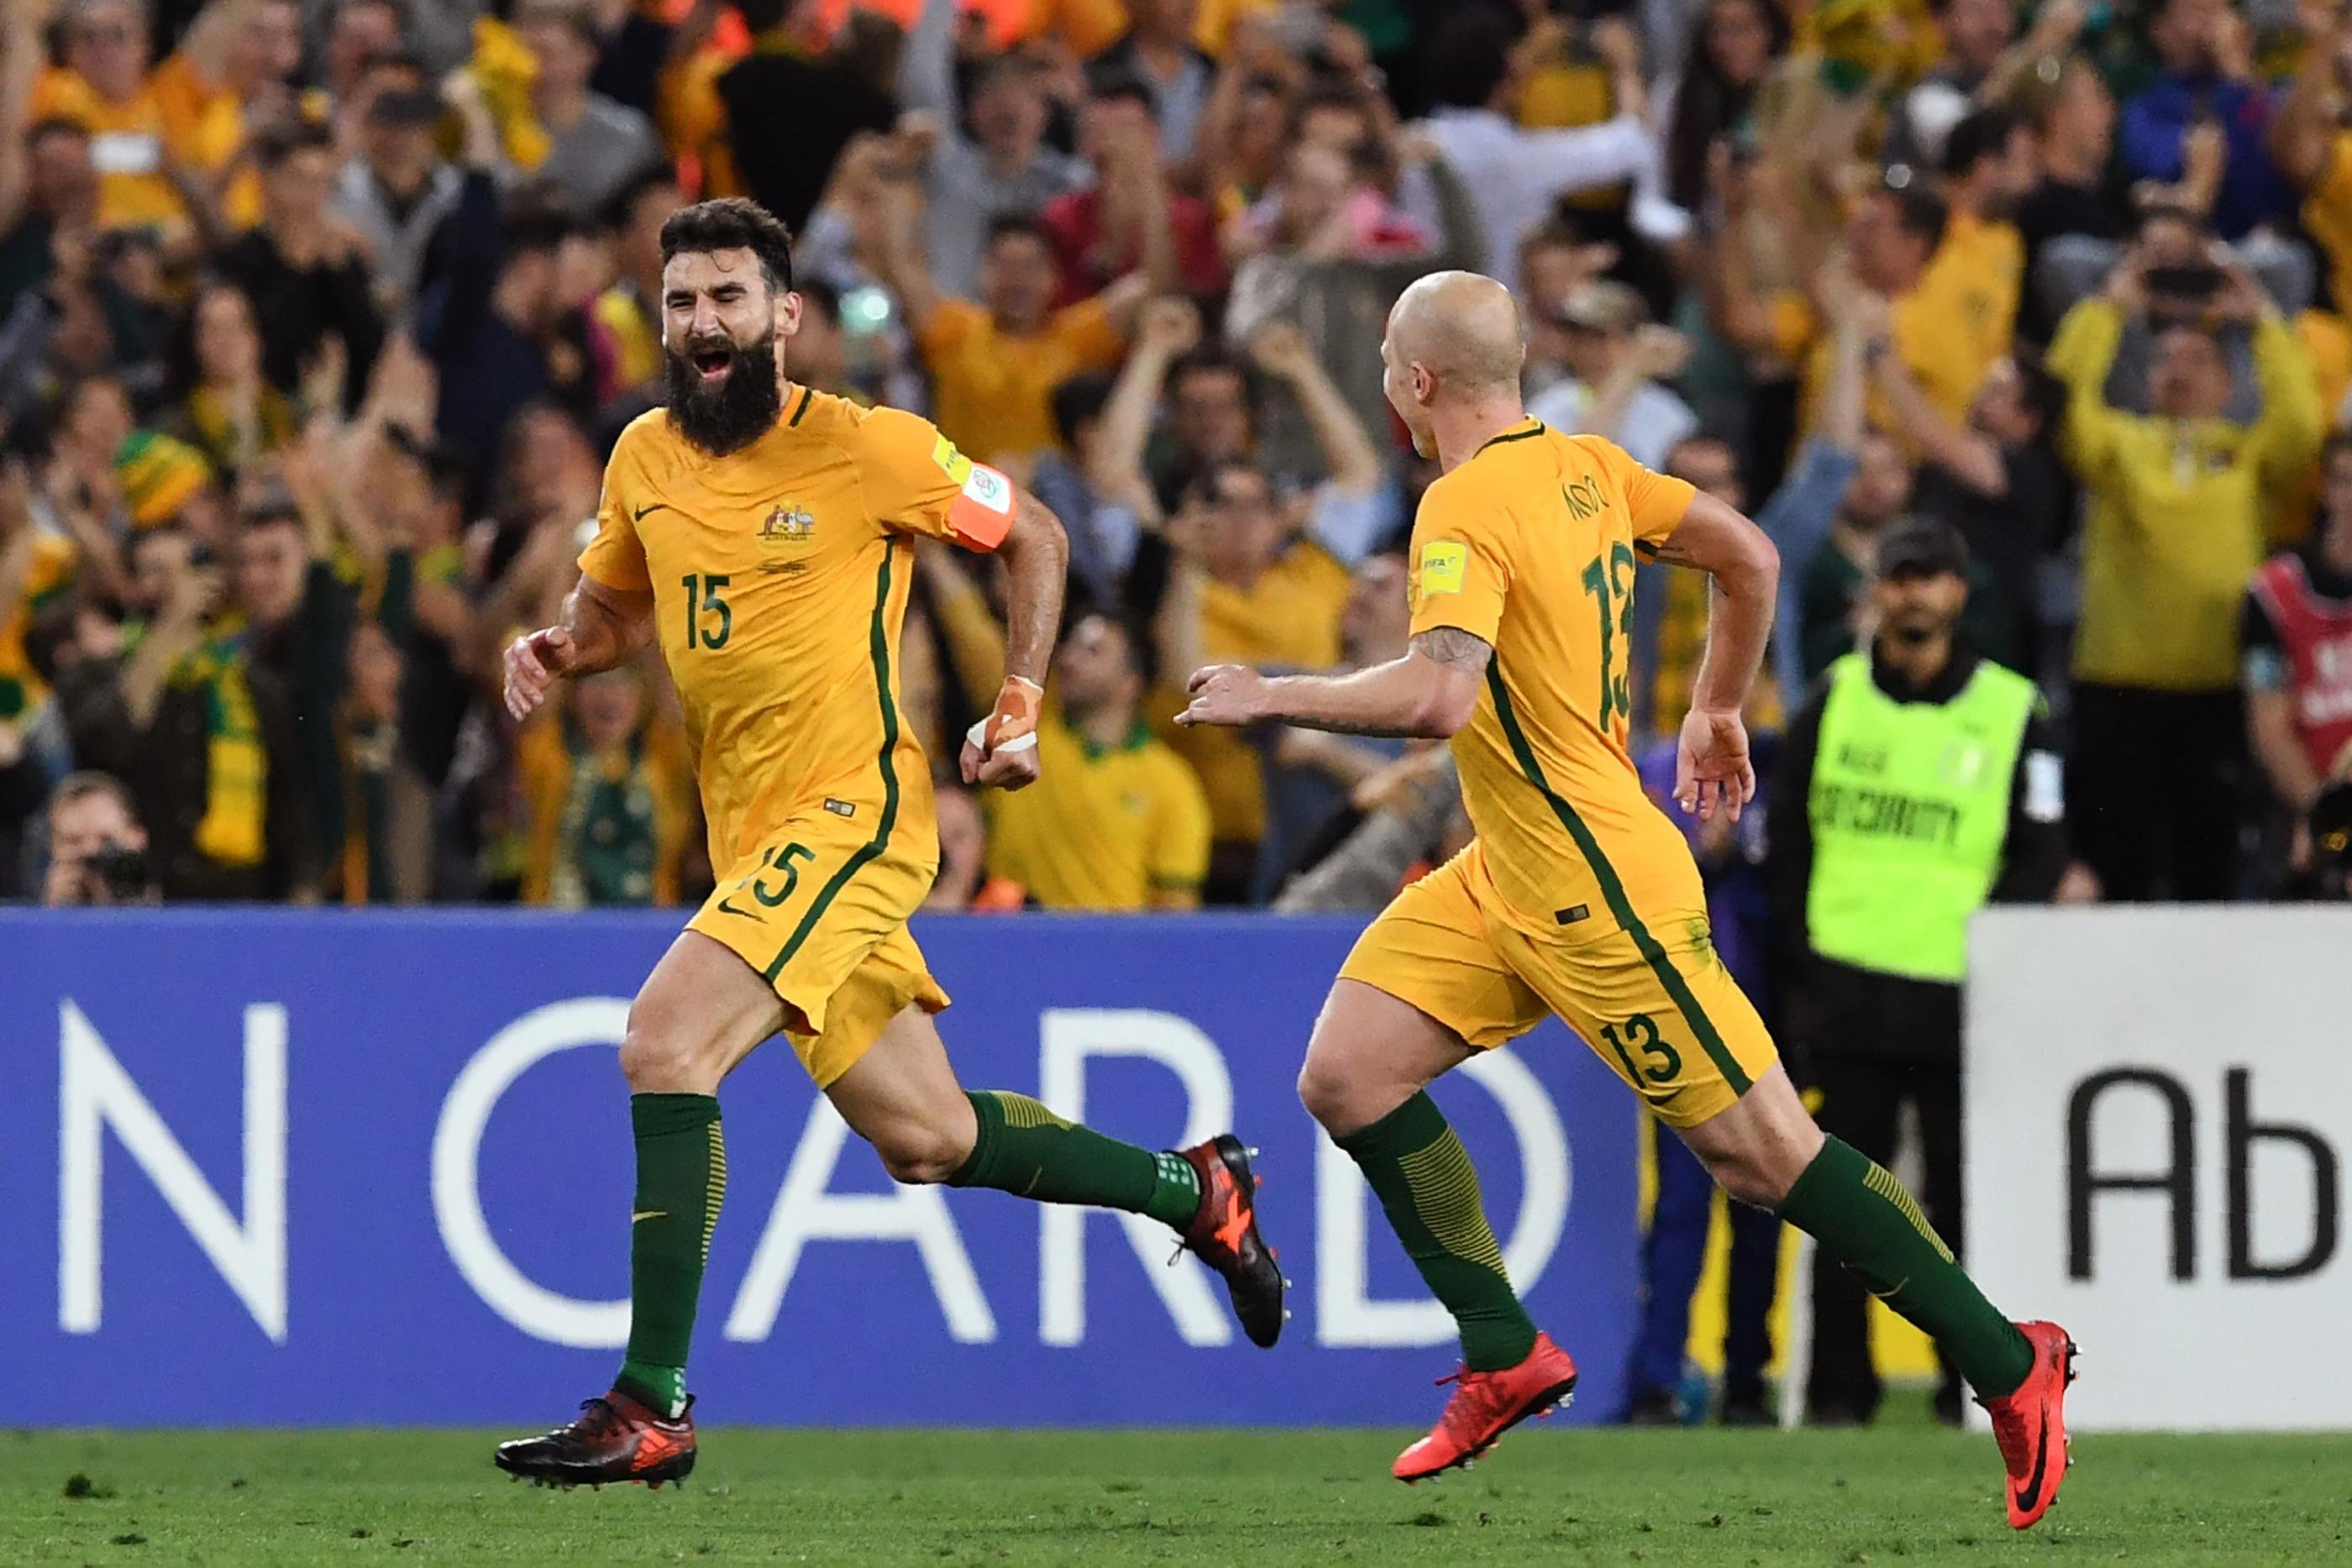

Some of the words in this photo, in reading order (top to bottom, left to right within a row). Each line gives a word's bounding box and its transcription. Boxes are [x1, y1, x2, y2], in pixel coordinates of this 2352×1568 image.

[682, 573, 731, 649] 15
[1424, 558, 1446, 569] FIFA
[1582, 540, 1633, 733] 13
[1600, 1013, 1682, 1089] 13
[58, 997, 288, 1345] N
[431, 995, 1571, 1349] CARD
[2066, 1062, 2340, 1283] Ab
